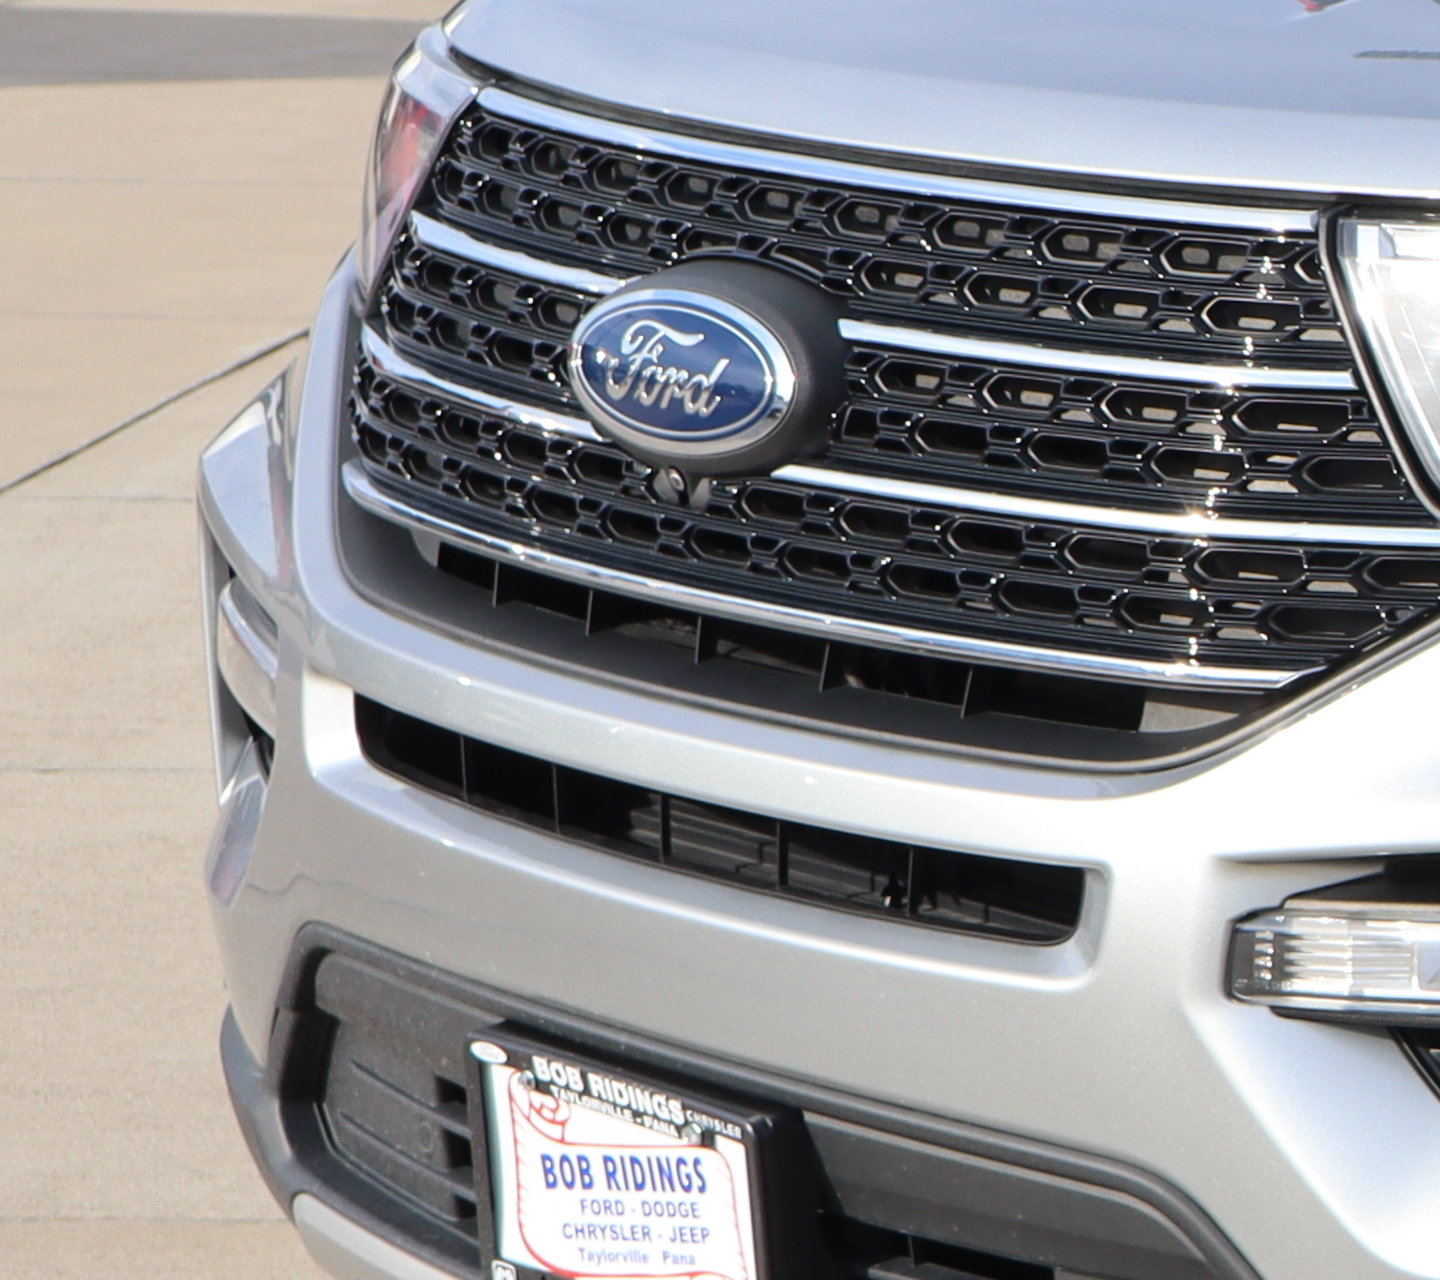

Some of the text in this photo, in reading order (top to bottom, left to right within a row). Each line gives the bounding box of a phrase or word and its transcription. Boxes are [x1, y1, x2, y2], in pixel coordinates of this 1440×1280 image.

[597, 319, 731, 418] Ford
[532, 1055, 686, 1126] BOB RIDINGS
[540, 1153, 707, 1194] BOB RIDINGS
[580, 1198, 625, 1216] FORD
[641, 1200, 702, 1219] DODGE
[562, 1222, 653, 1243] CHRYSLER
[669, 1225, 711, 1245] JEEP
[578, 1247, 696, 1266] Taylorville Pana
